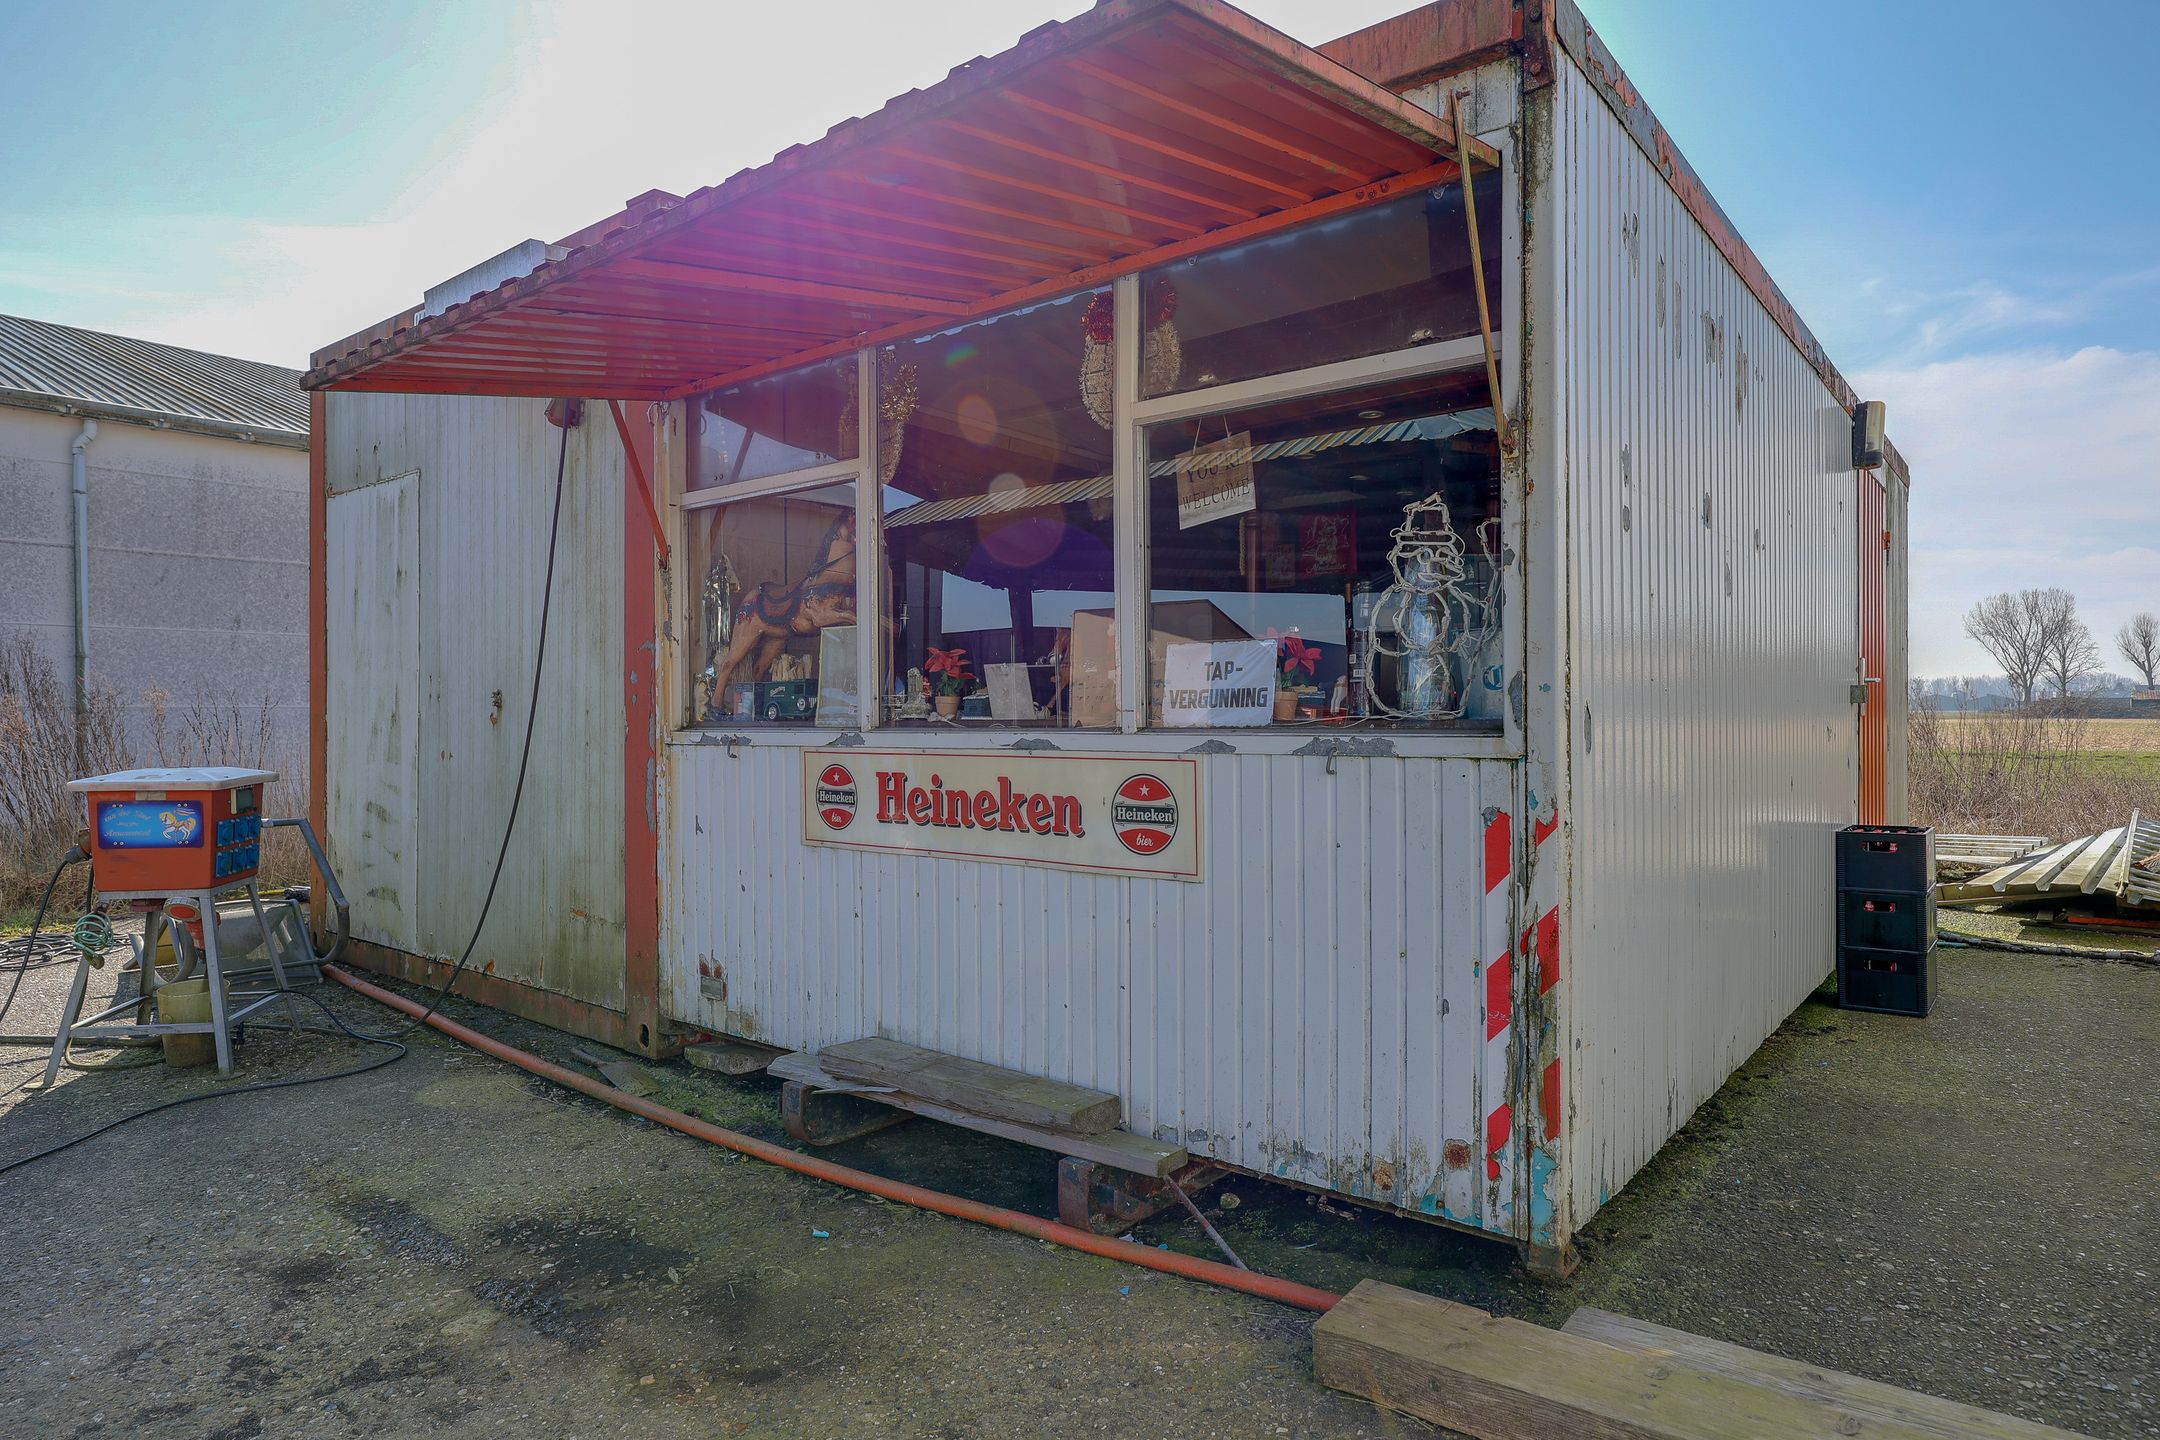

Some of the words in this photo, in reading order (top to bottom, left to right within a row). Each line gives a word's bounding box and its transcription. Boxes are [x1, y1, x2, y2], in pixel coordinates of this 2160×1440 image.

[1183, 477, 1251, 511] WELCOME
[1204, 661, 1243, 681] TAP-
[1170, 687, 1268, 709] VERGUNNING
[819, 790, 854, 804] Heineken
[875, 771, 1086, 838] Heineken
[1116, 806, 1173, 822] Heineken
[1136, 832, 1154, 846] bier
